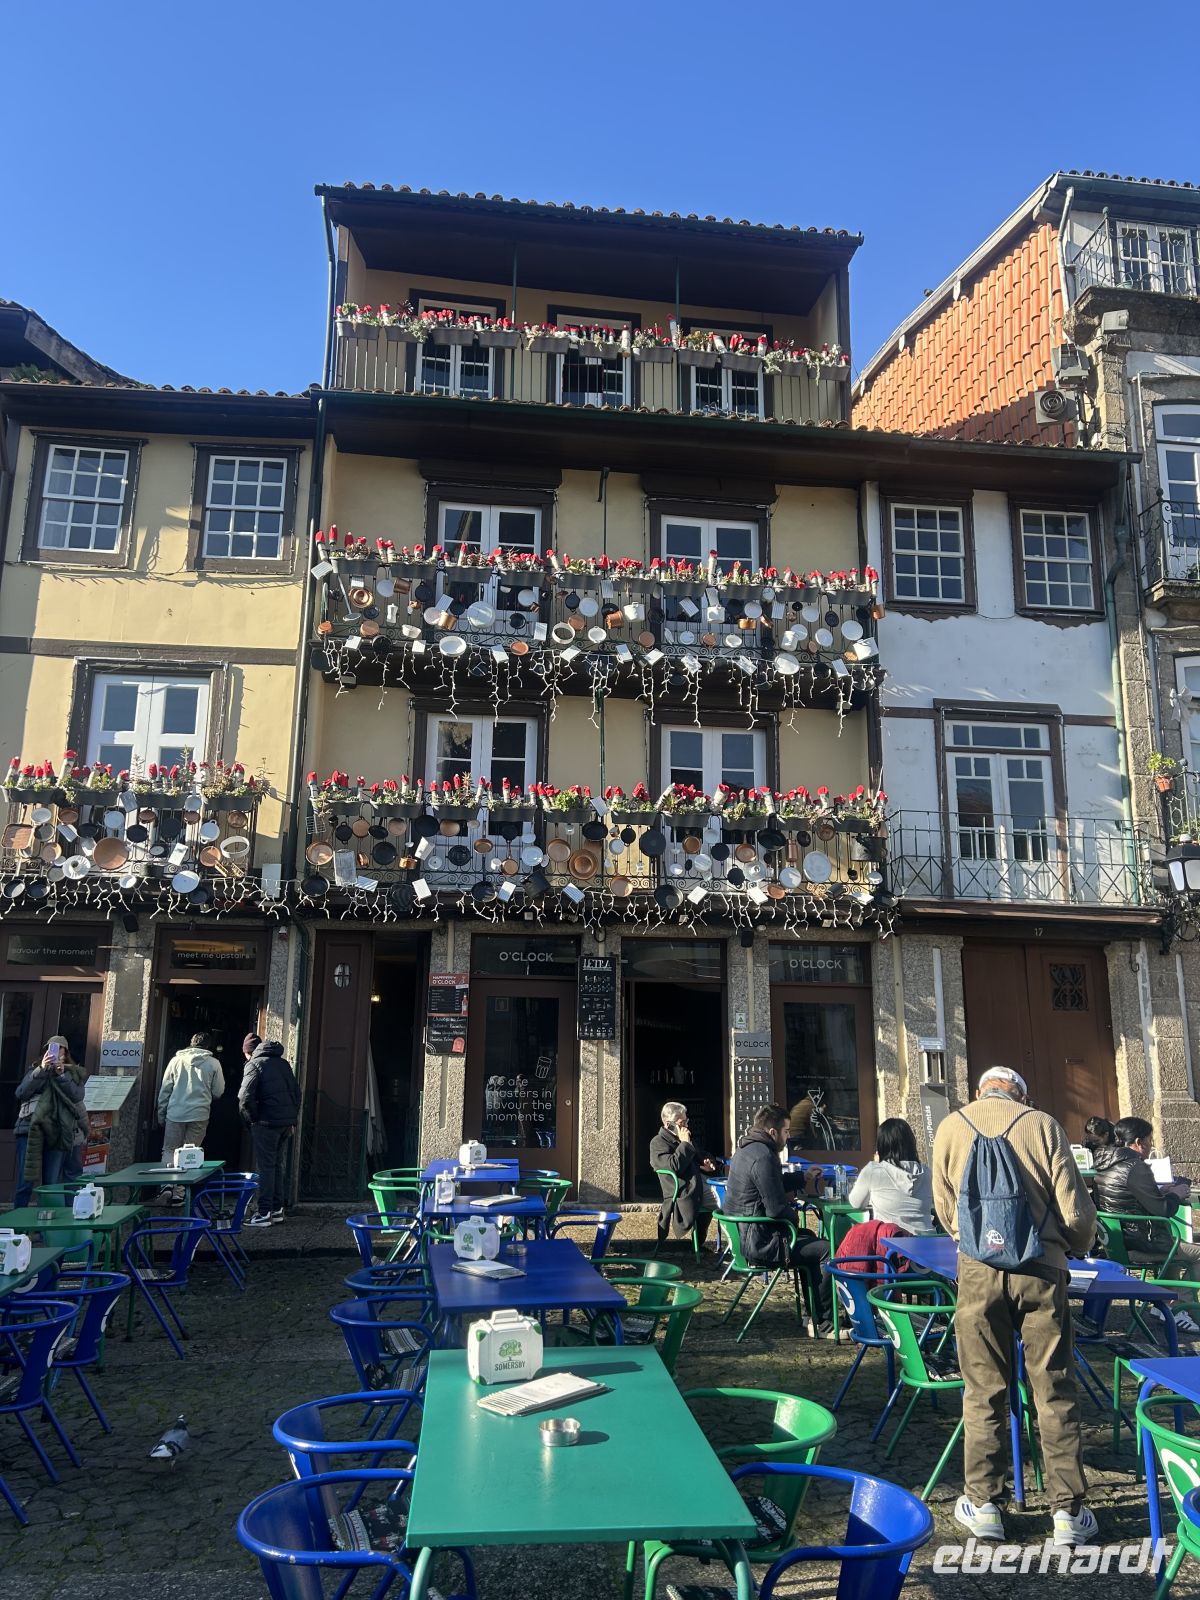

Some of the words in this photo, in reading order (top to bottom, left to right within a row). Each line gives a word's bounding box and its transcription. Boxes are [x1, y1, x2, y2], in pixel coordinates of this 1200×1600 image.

[1034, 928, 1043, 937] 17
[43, 947, 57, 955] the
[58, 948, 94, 956] moment
[499, 951, 554, 963] O'CLOCK
[789, 959, 842, 970] O'CLOCK
[735, 1040, 770, 1048] O'CLOCK
[102, 1049, 141, 1057] O'CLOCK
[507, 1078, 529, 1086] are
[487, 1088, 539, 1098] masters
[541, 1087, 552, 1098] in
[486, 1101, 528, 1110] savour
[531, 1100, 552, 1110] the
[486, 1112, 545, 1122] moments
[494, 1360, 526, 1372] SOMERSBY
